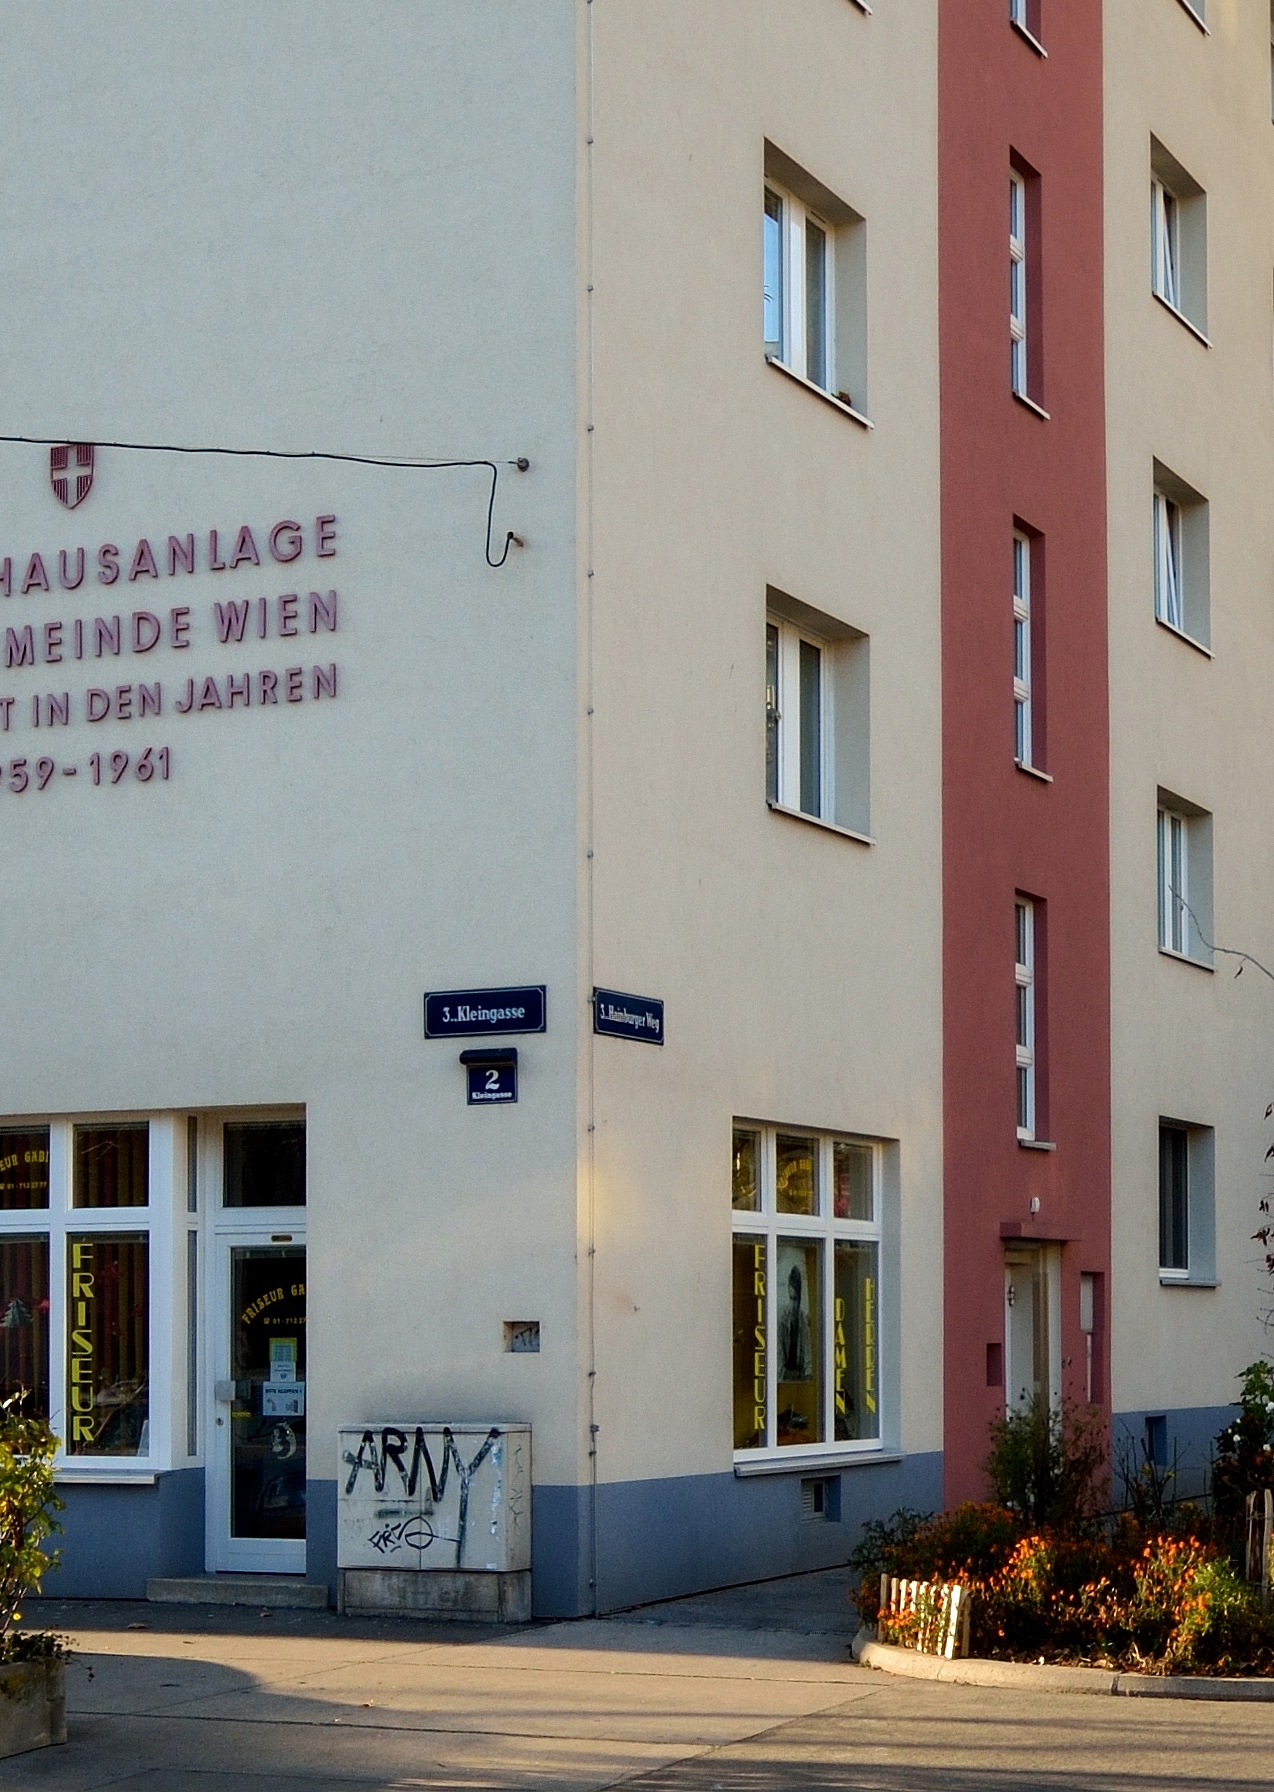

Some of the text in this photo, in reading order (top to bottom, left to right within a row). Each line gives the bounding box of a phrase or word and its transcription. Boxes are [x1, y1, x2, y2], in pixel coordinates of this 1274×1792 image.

[214, 589, 337, 643] WIEN
[32, 692, 69, 728] IN
[86, 682, 161, 722] DEN
[175, 663, 337, 714] JAHREN
[457, 1005, 525, 1024] Kleingasse
[646, 1011, 660, 1034] Weg
[485, 1069, 500, 1090] 2
[24, 1150, 49, 1163] GABI
[241, 1284, 306, 1324] FRISEUR GA
[72, 1243, 95, 1441] FRISEUR
[754, 1244, 766, 1430] FRISEUR
[835, 1298, 847, 1414] DAMEN
